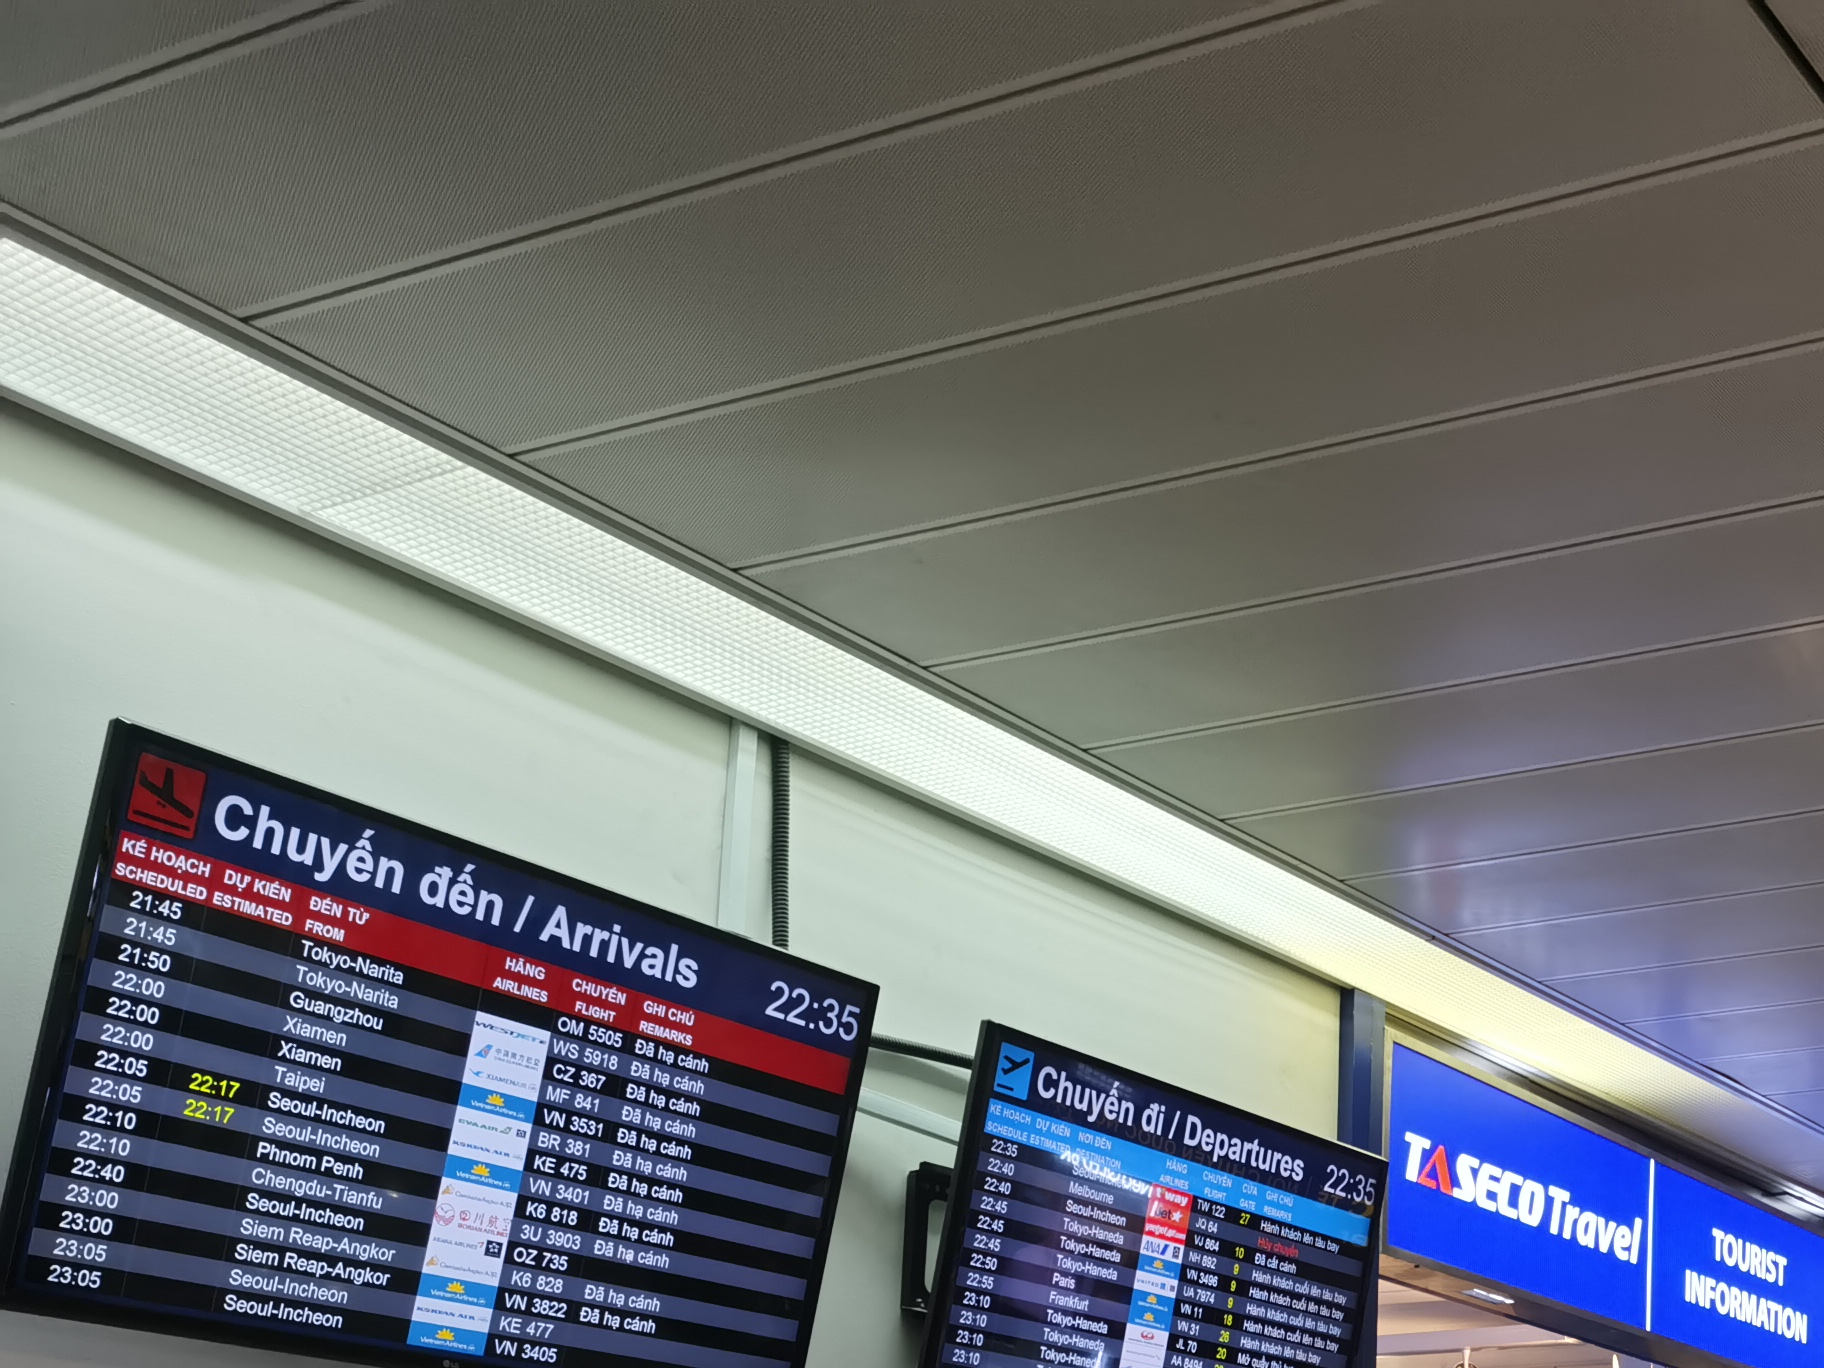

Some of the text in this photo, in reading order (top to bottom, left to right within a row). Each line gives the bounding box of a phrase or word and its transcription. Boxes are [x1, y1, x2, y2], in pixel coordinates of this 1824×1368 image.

[115, 863, 692, 1045] SCHEDULED ESTIMATED FROM AIRLINES FLIGHT REMARKS
[130, 891, 182, 919] 21:45
[302, 940, 403, 984] Tokyo-Narita
[558, 1017, 584, 1036] OM
[588, 1025, 622, 1047] 5505
[635, 1039, 654, 1057] Đã
[658, 1046, 674, 1065] hạ
[678, 1054, 708, 1073] cánh
[151, 847, 210, 877] HOẠCH
[224, 869, 251, 891] DỰ
[348, 907, 370, 924] TỪ
[505, 957, 545, 979] HÃNG
[644, 1001, 666, 1017] GHI
[215, 795, 404, 894] Chuyến
[420, 864, 503, 926] đến
[539, 905, 698, 988] Arrivals
[765, 981, 860, 1040] 22:35
[118, 944, 700, 1116] 21:50 Guangzhou CZ 367 Đã hạ cánh
[83, 1104, 674, 1246] 22:10 Phnom Penh K6 818 Đã hạ cánh
[95, 1050, 148, 1077] 22:05
[189, 1073, 240, 1098] 22:17
[268, 1092, 385, 1133] Seoul-Incheon
[534, 1155, 556, 1173] KE
[560, 1162, 587, 1180] 475
[608, 1173, 627, 1190] Đã
[631, 1178, 648, 1197] hạ
[651, 1185, 682, 1203] cánh
[988, 1158, 1114, 1204] 22:40 Melbourne
[1038, 1066, 1134, 1126] Chuyến
[1142, 1103, 1165, 1135] đi
[1184, 1115, 1304, 1181] Departures
[1324, 1165, 1376, 1205] 22:35
[1142, 1239, 1160, 1254] ANA
[1548, 1184, 1643, 1264] Travel
[1712, 1228, 1787, 1286] TOURIST
[967, 1273, 1229, 1342] 22:55 Frankfurt VN 31 26
[1685, 1270, 1807, 1344] INFORMATION
